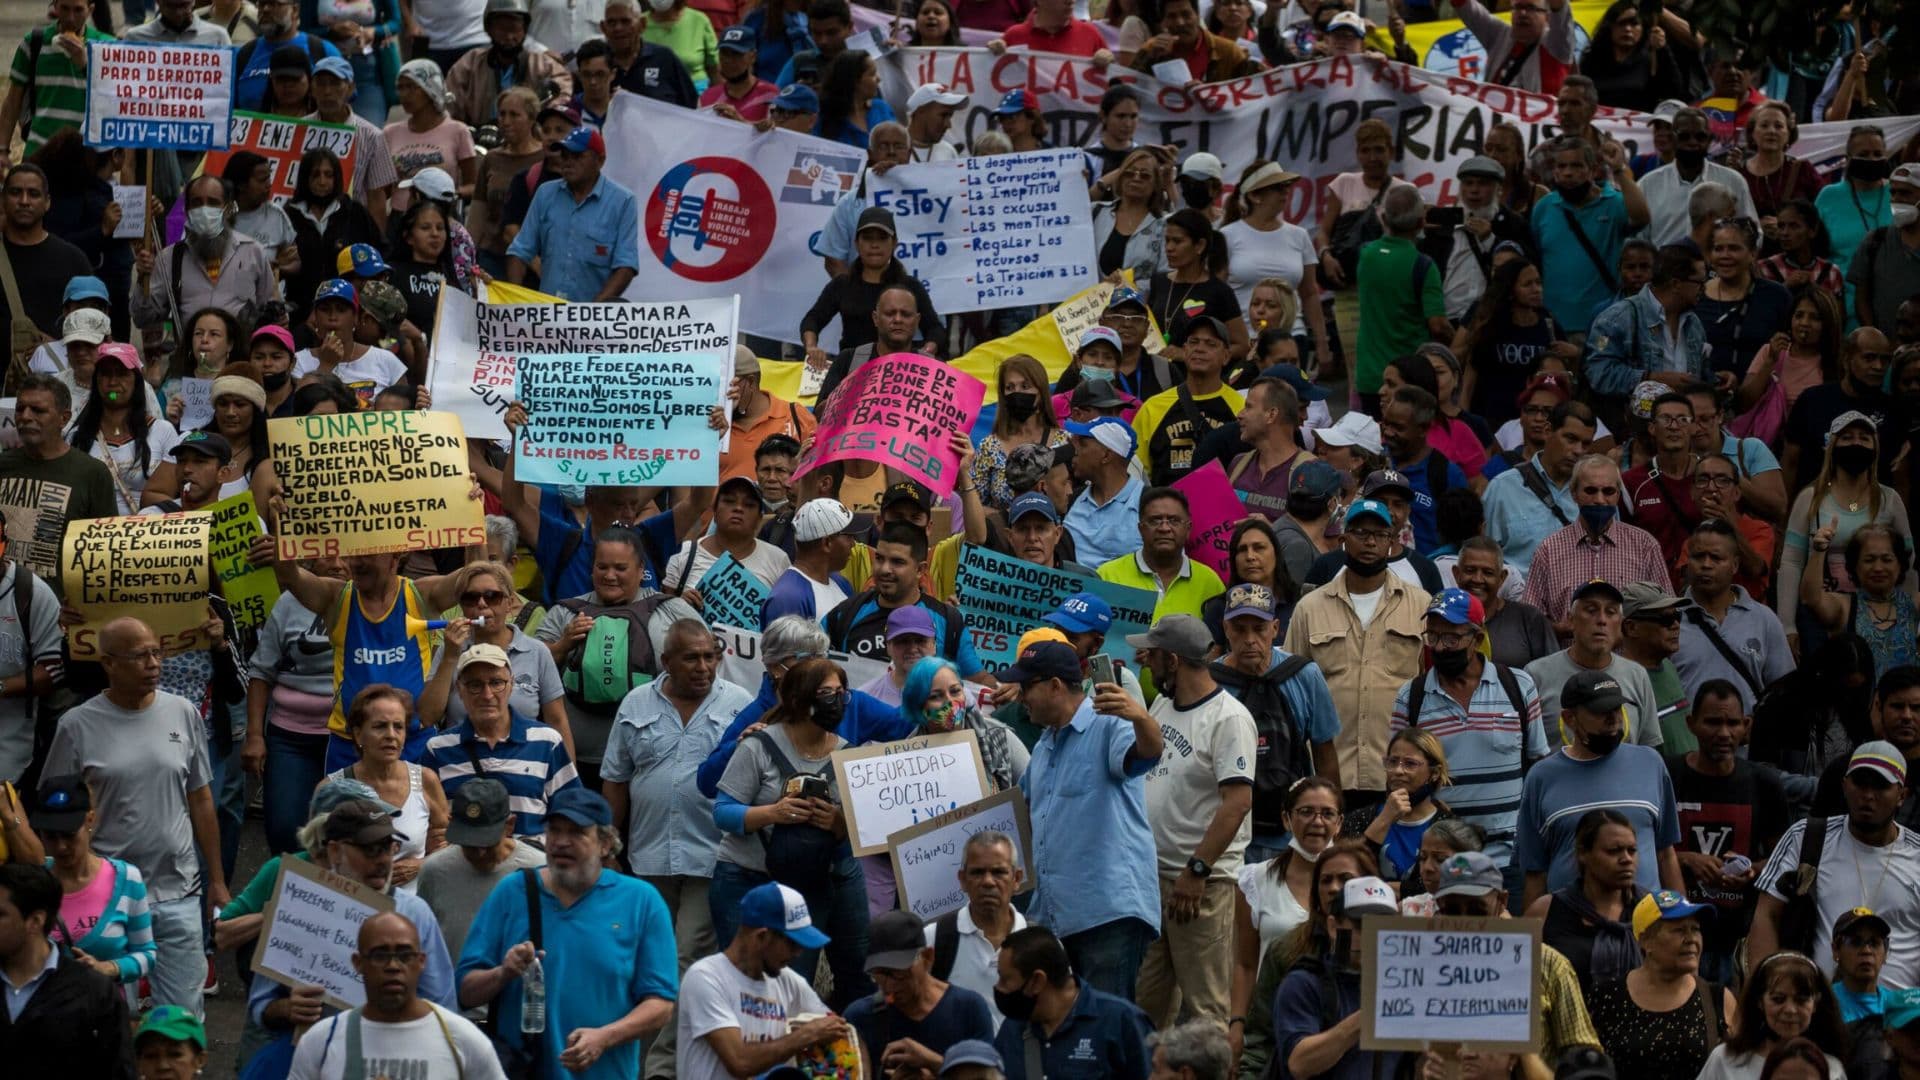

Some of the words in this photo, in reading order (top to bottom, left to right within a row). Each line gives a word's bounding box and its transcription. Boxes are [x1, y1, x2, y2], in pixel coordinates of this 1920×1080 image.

[102, 48, 156, 64] UNIDAD
[163, 51, 220, 67] OBRERA
[101, 66, 140, 79] PARA
[147, 68, 223, 84] DERROTAR
[1158, 56, 1353, 113] OBRERA
[1372, 60, 1429, 95] AL
[116, 84, 132, 98] LA
[139, 85, 203, 100] POLITICA
[120, 101, 205, 118] NEOLIBERAL
[105, 121, 211, 144] CUTV-FNLCT
[260, 121, 294, 149] ENE
[304, 128, 353, 157] 2023
[712, 201, 750, 216] TRABAJO
[1003, 202, 1057, 215] excusas
[710, 212, 733, 224] LIBRE
[735, 216, 746, 226] DE
[707, 221, 750, 237] VIOLENCIA
[711, 233, 739, 245] ACOSO
[895, 232, 947, 259] arTo
[976, 252, 1040, 267] recursos
[1059, 266, 1068, 277] a
[1072, 264, 1088, 277] La
[554, 302, 691, 321] FEDECAMARA
[532, 320, 613, 340] CENTRAL
[613, 322, 715, 341] SOCIALISTA
[517, 357, 583, 373] ONAPRE
[587, 356, 694, 374] FEDECAMARA
[562, 371, 628, 387] CENTRAL
[628, 372, 713, 387] SOCIALISTA
[935, 369, 957, 388] DE
[521, 384, 591, 399] REGIRAN
[591, 384, 673, 401] NUESTROS
[930, 382, 953, 401] EN
[593, 399, 650, 415] SOMOS
[653, 401, 715, 417] LIBRES
[661, 415, 673, 431] Y
[519, 425, 624, 444] AUTONOMO
[273, 442, 301, 459] MIS
[309, 438, 390, 456] DERECHOS
[392, 435, 415, 450] NO
[419, 433, 460, 449] SON
[522, 441, 609, 460] EXIGIMOS
[612, 443, 701, 460] RESPETO
[273, 459, 291, 475] DE
[295, 455, 368, 473] DERECHA
[372, 451, 391, 469] NI
[401, 447, 425, 464] DE
[278, 470, 386, 490] IZQUIERDA
[387, 464, 427, 482] SON
[430, 462, 463, 478] DEL
[354, 499, 368, 517] A
[368, 497, 447, 515] NUESTRA
[80, 529, 123, 540] NADA
[124, 527, 145, 539] LO
[150, 526, 200, 536] UNICO
[88, 523, 115, 532] NO
[122, 516, 212, 530] QUEREMOS
[74, 538, 106, 552] QUE
[108, 538, 129, 552] LE
[130, 537, 202, 551] EXIGIMOS
[71, 550, 86, 571] A
[88, 551, 106, 571] LA
[110, 551, 204, 570] REVOLUCION
[963, 543, 1084, 594] TRABAJADORES
[84, 570, 106, 588] ES
[110, 569, 181, 588] RESPETO
[184, 567, 198, 586] A
[956, 564, 1039, 603] PRESENTES
[1040, 588, 1065, 609] PO
[83, 586, 106, 604] LA
[109, 589, 211, 605] CONSTITUCION
[709, 573, 760, 626] UNIDOS
[353, 646, 406, 665] SUTES
[885, 739, 929, 756] APUCV
[851, 752, 957, 789] SEGURIDAD
[878, 781, 947, 811] SOCIAL
[1383, 935, 1421, 957] SIN
[1432, 935, 1504, 956] SALARIO
[1384, 966, 1424, 989] SIN
[1436, 965, 1501, 987] SALUD
[1382, 998, 1415, 1016] NOS
[1425, 998, 1529, 1017] EXTERMINAN
